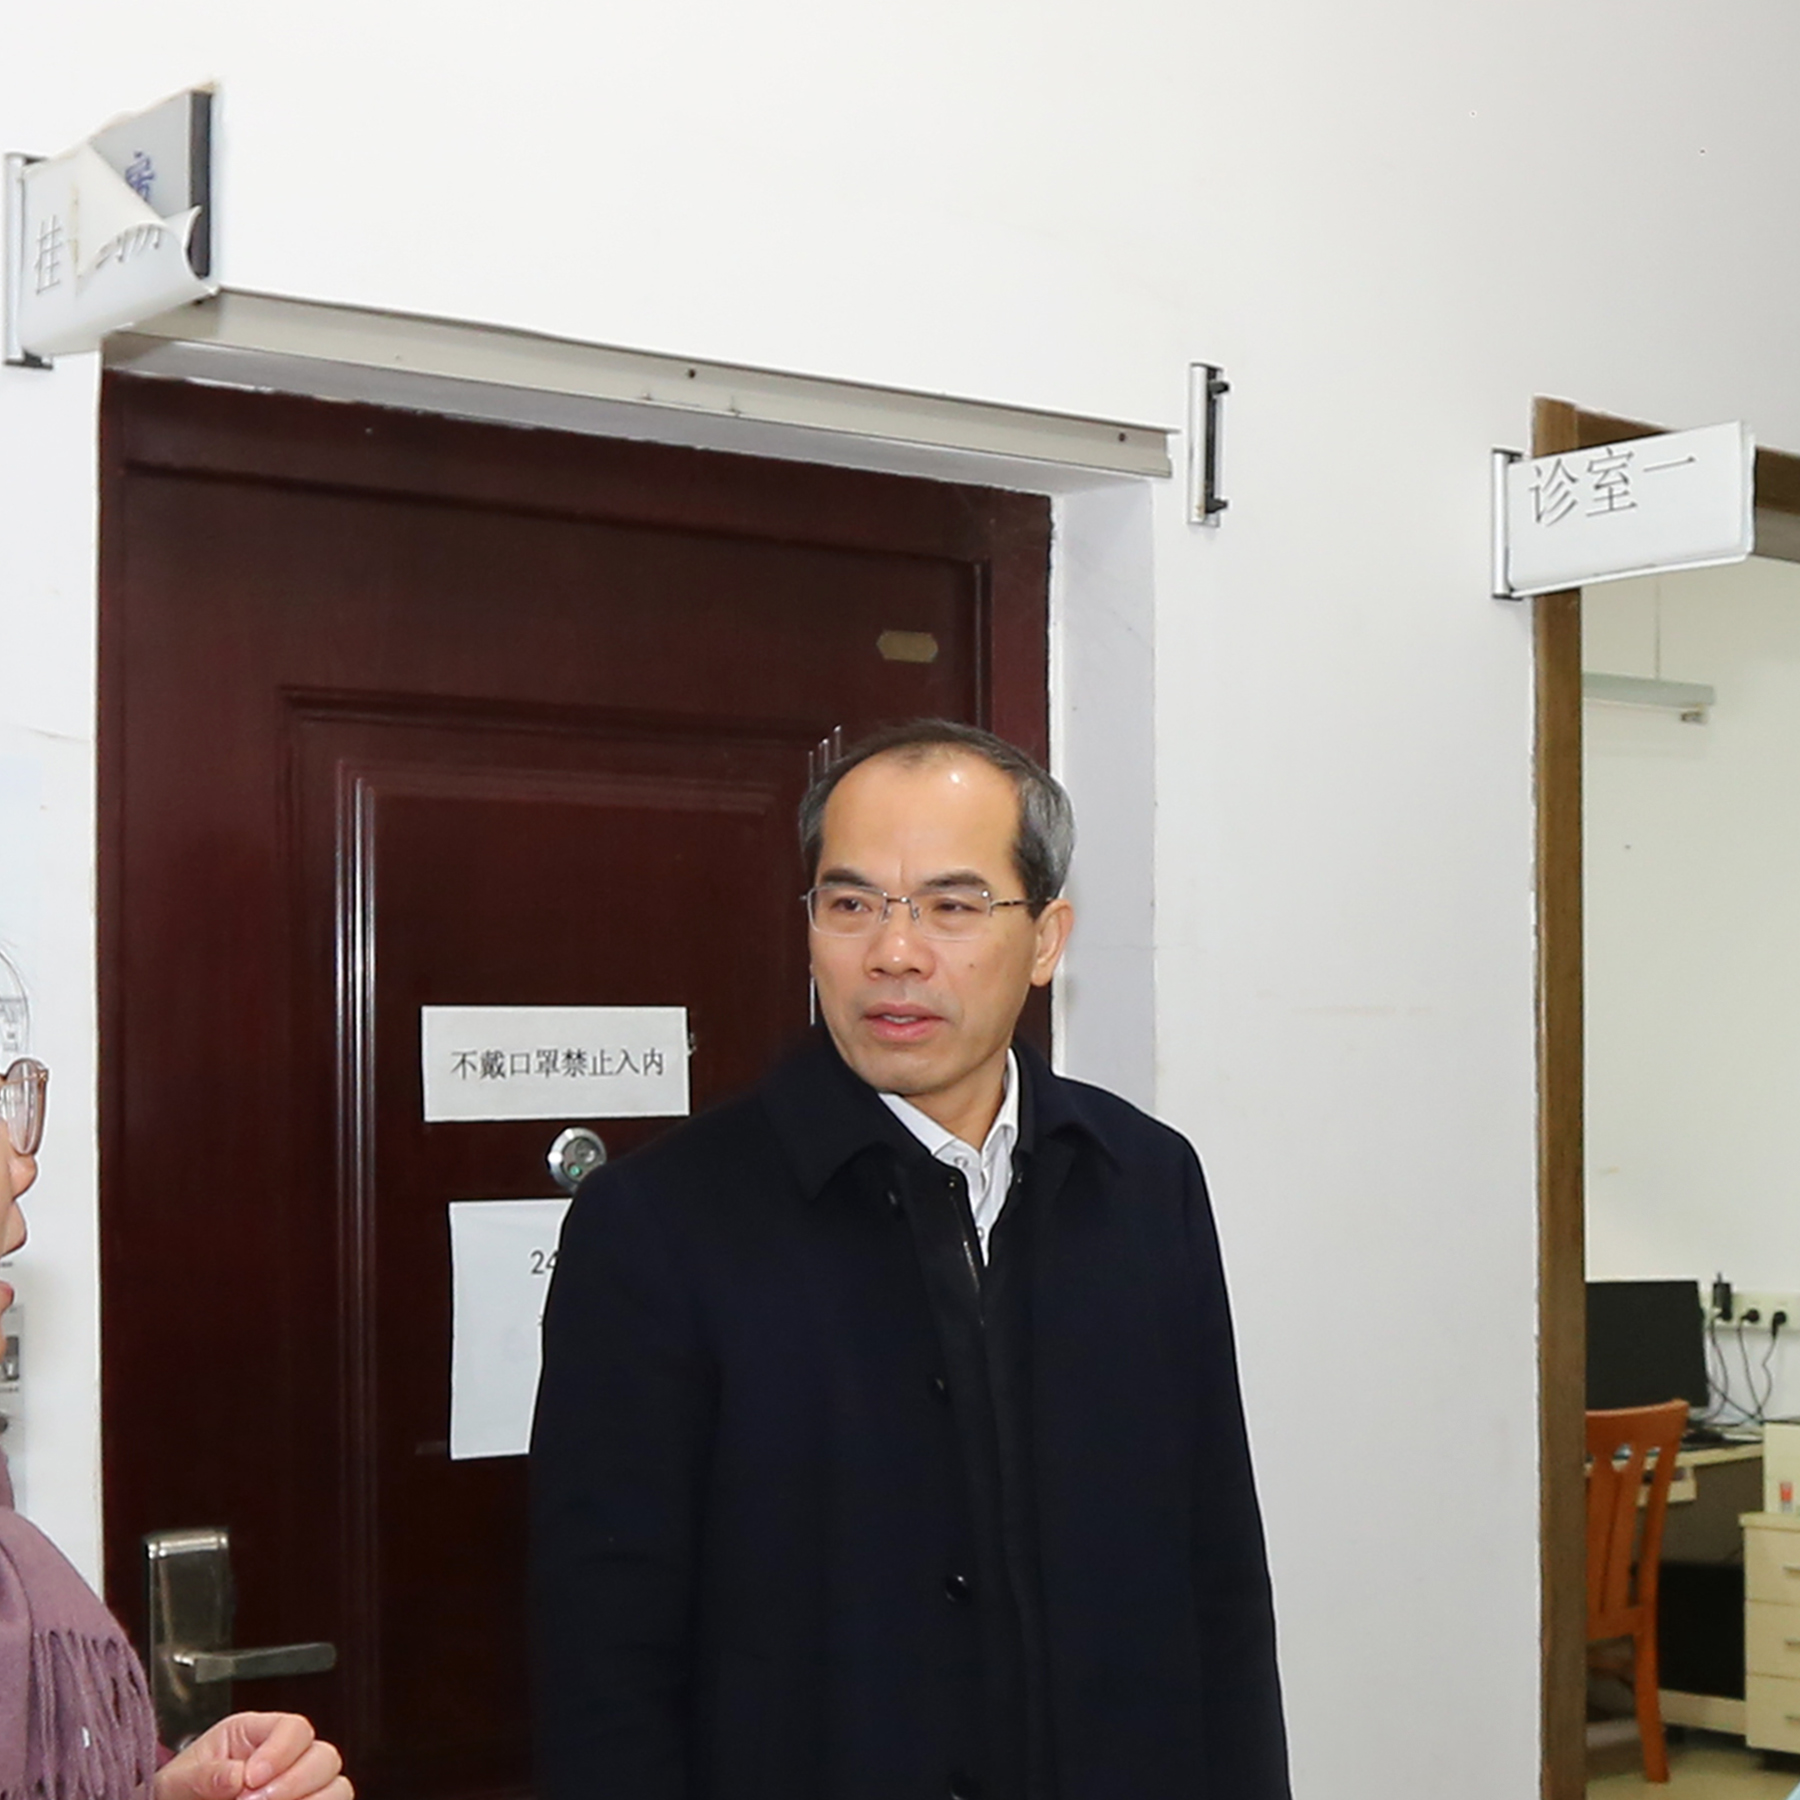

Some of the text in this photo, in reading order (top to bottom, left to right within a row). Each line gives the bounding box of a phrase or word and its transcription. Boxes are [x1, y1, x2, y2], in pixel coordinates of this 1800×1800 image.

[1527, 447, 1696, 528] 诊室一
[450, 1046, 665, 1081] 不戴口罩禁止入内
